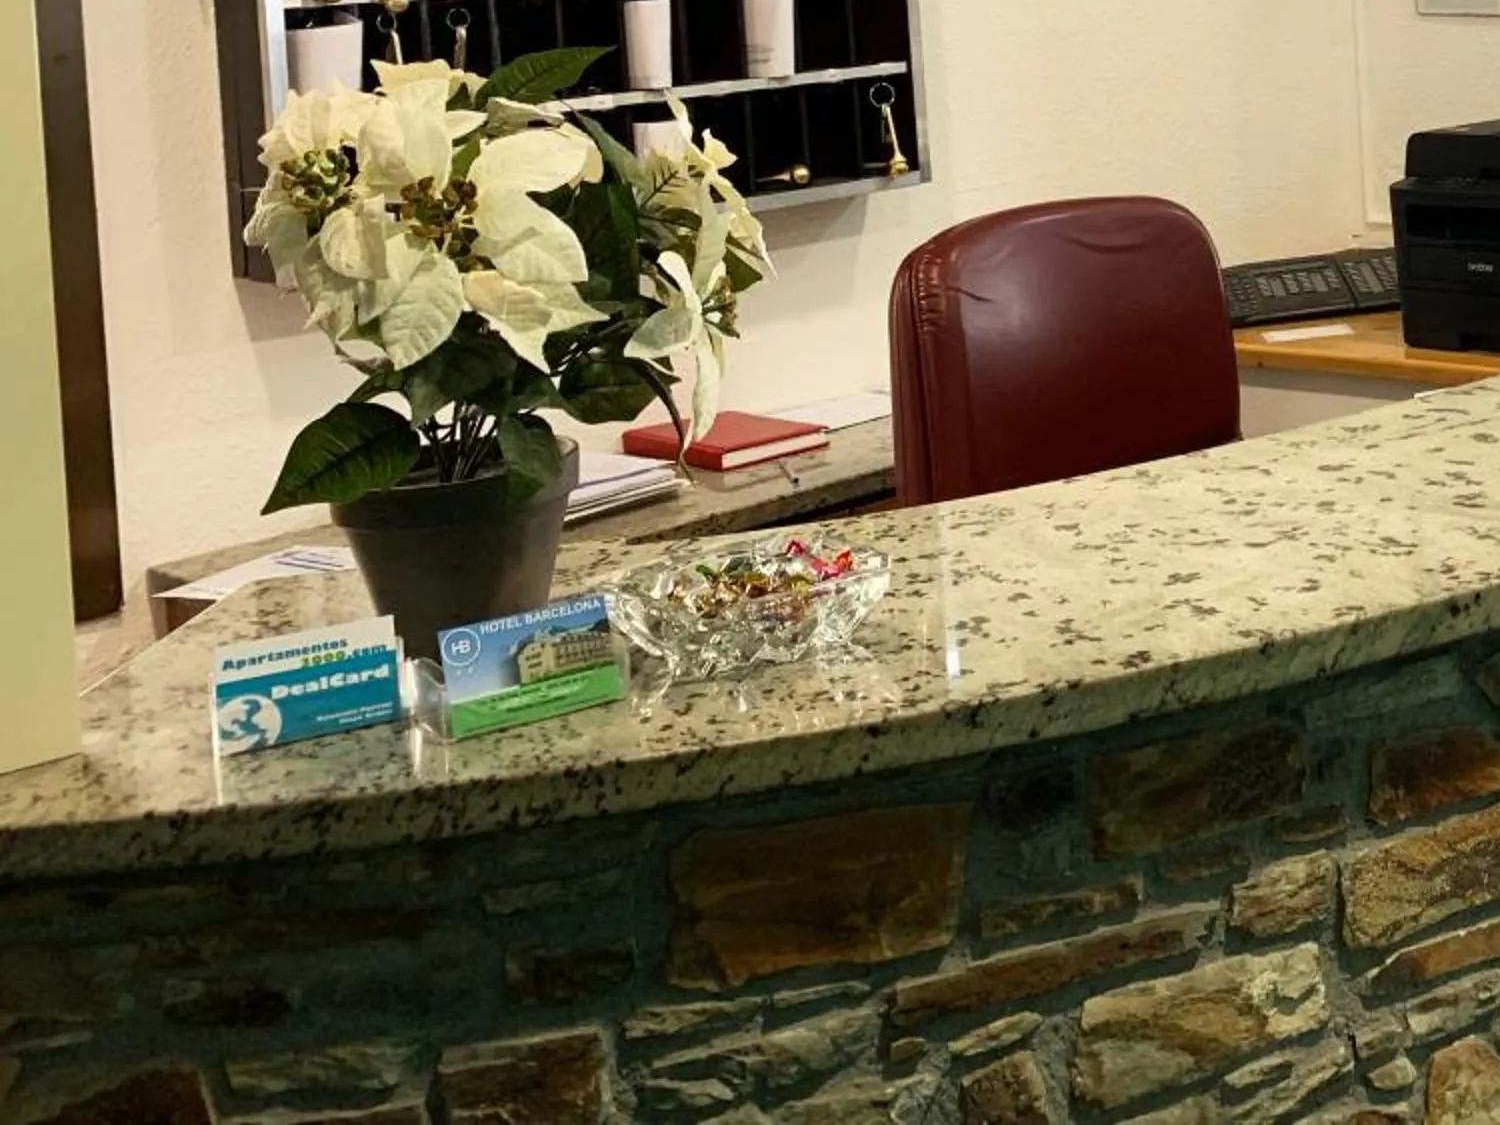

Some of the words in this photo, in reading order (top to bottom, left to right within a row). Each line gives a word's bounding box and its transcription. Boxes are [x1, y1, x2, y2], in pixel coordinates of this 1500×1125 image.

[479, 619, 523, 636] HOTEL
[524, 598, 601, 625] BARCELONA
[451, 639, 472, 656] HB
